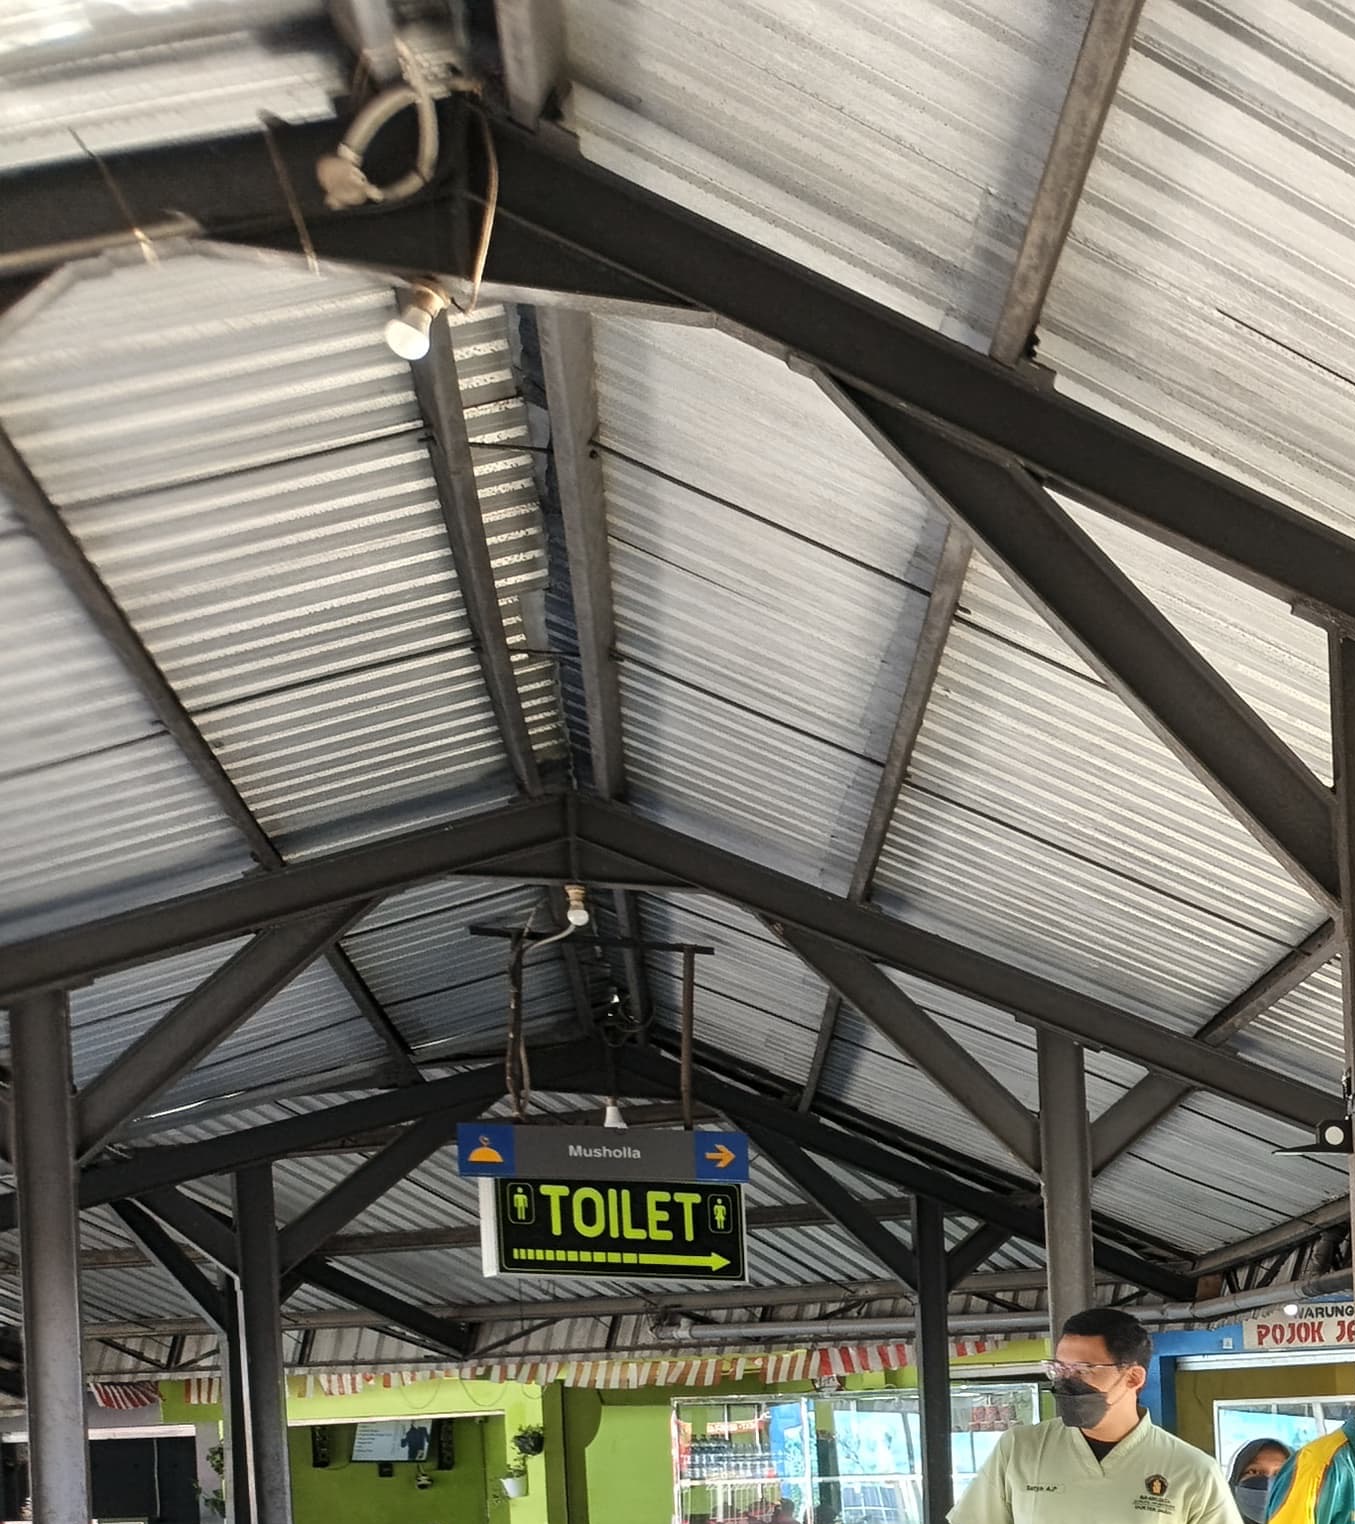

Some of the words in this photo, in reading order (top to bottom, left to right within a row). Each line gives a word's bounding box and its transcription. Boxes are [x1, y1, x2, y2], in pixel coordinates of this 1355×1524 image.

[568, 1144, 641, 1160] Musholla
[539, 1184, 702, 1241] TOILET
[1257, 1321, 1324, 1345] POJOK
